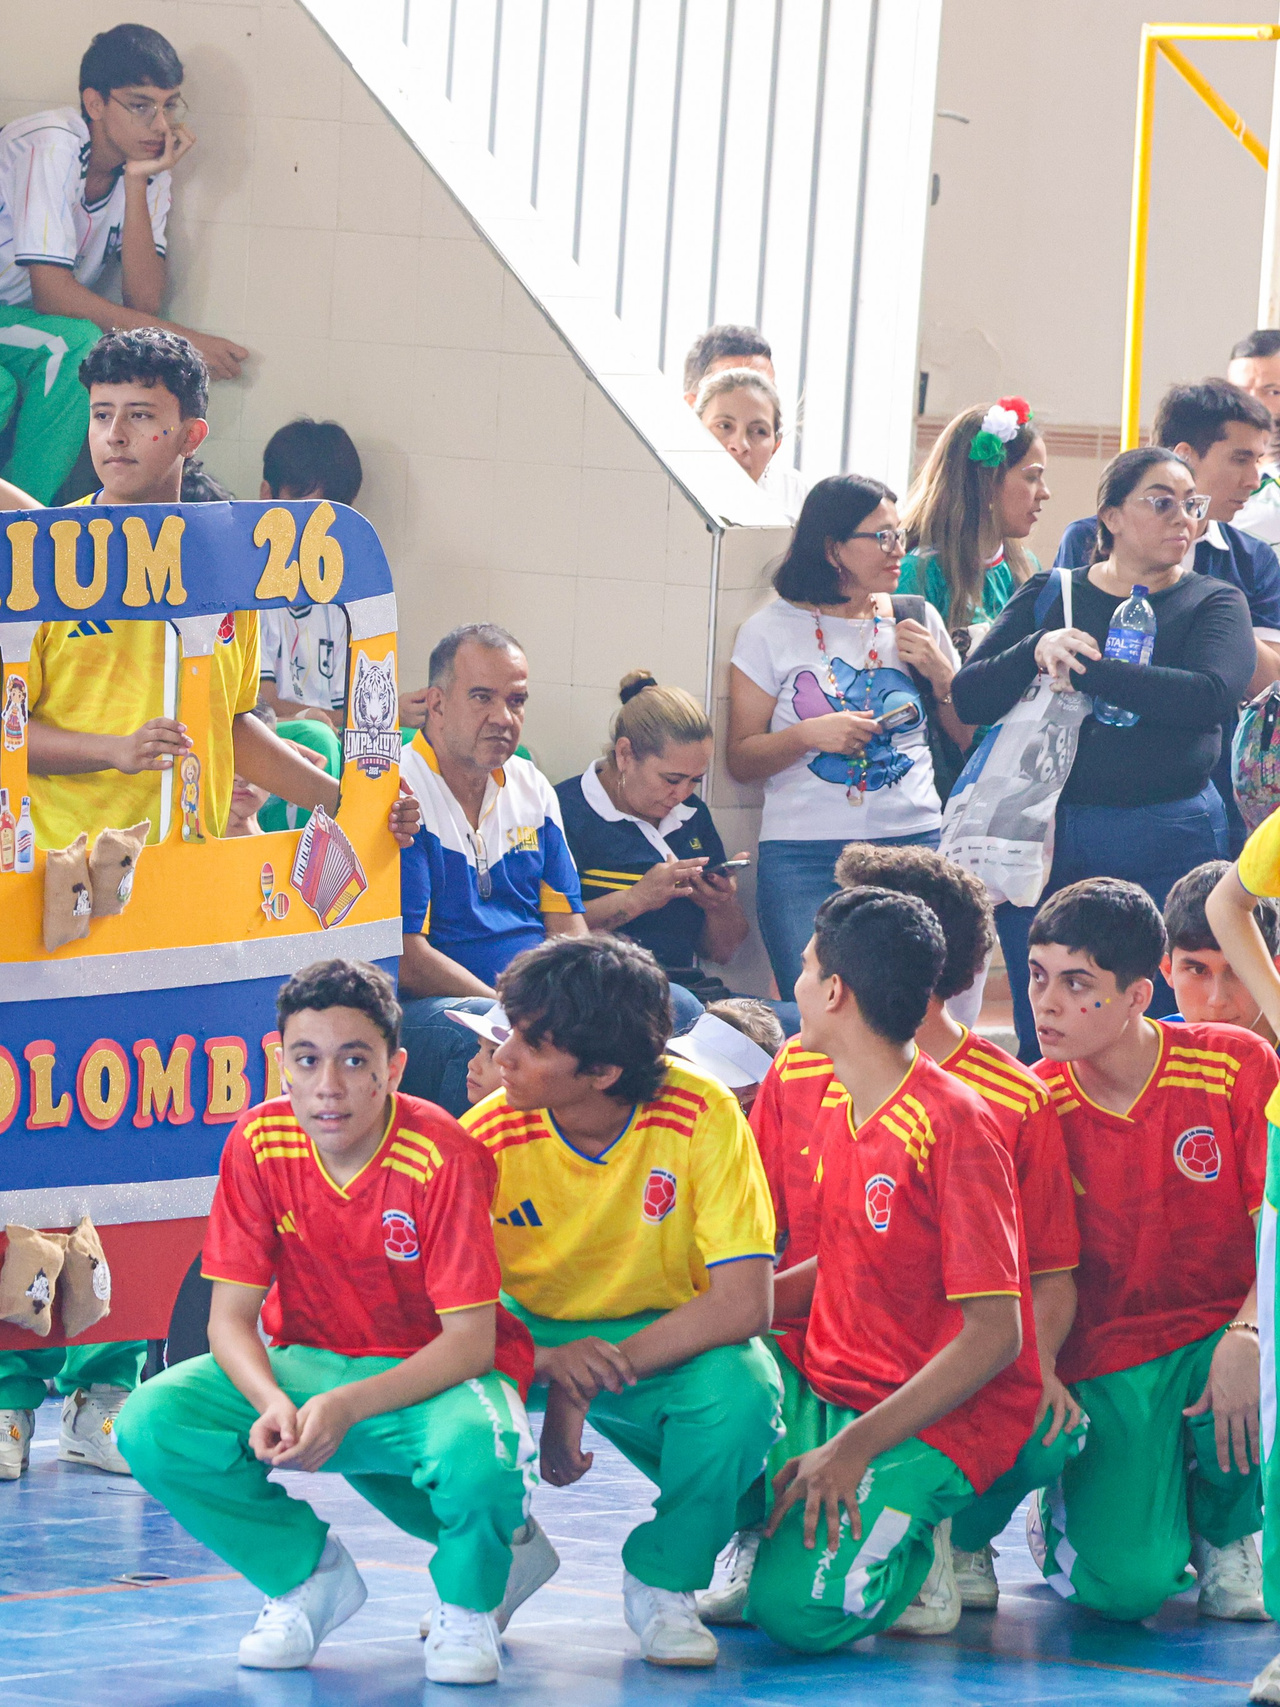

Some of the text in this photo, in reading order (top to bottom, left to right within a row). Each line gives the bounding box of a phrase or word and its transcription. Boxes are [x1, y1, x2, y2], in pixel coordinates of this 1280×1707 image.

[253, 500, 344, 604] 26
[1106, 636, 1128, 649] STAL
[346, 732, 400, 761] IMPERIUM
